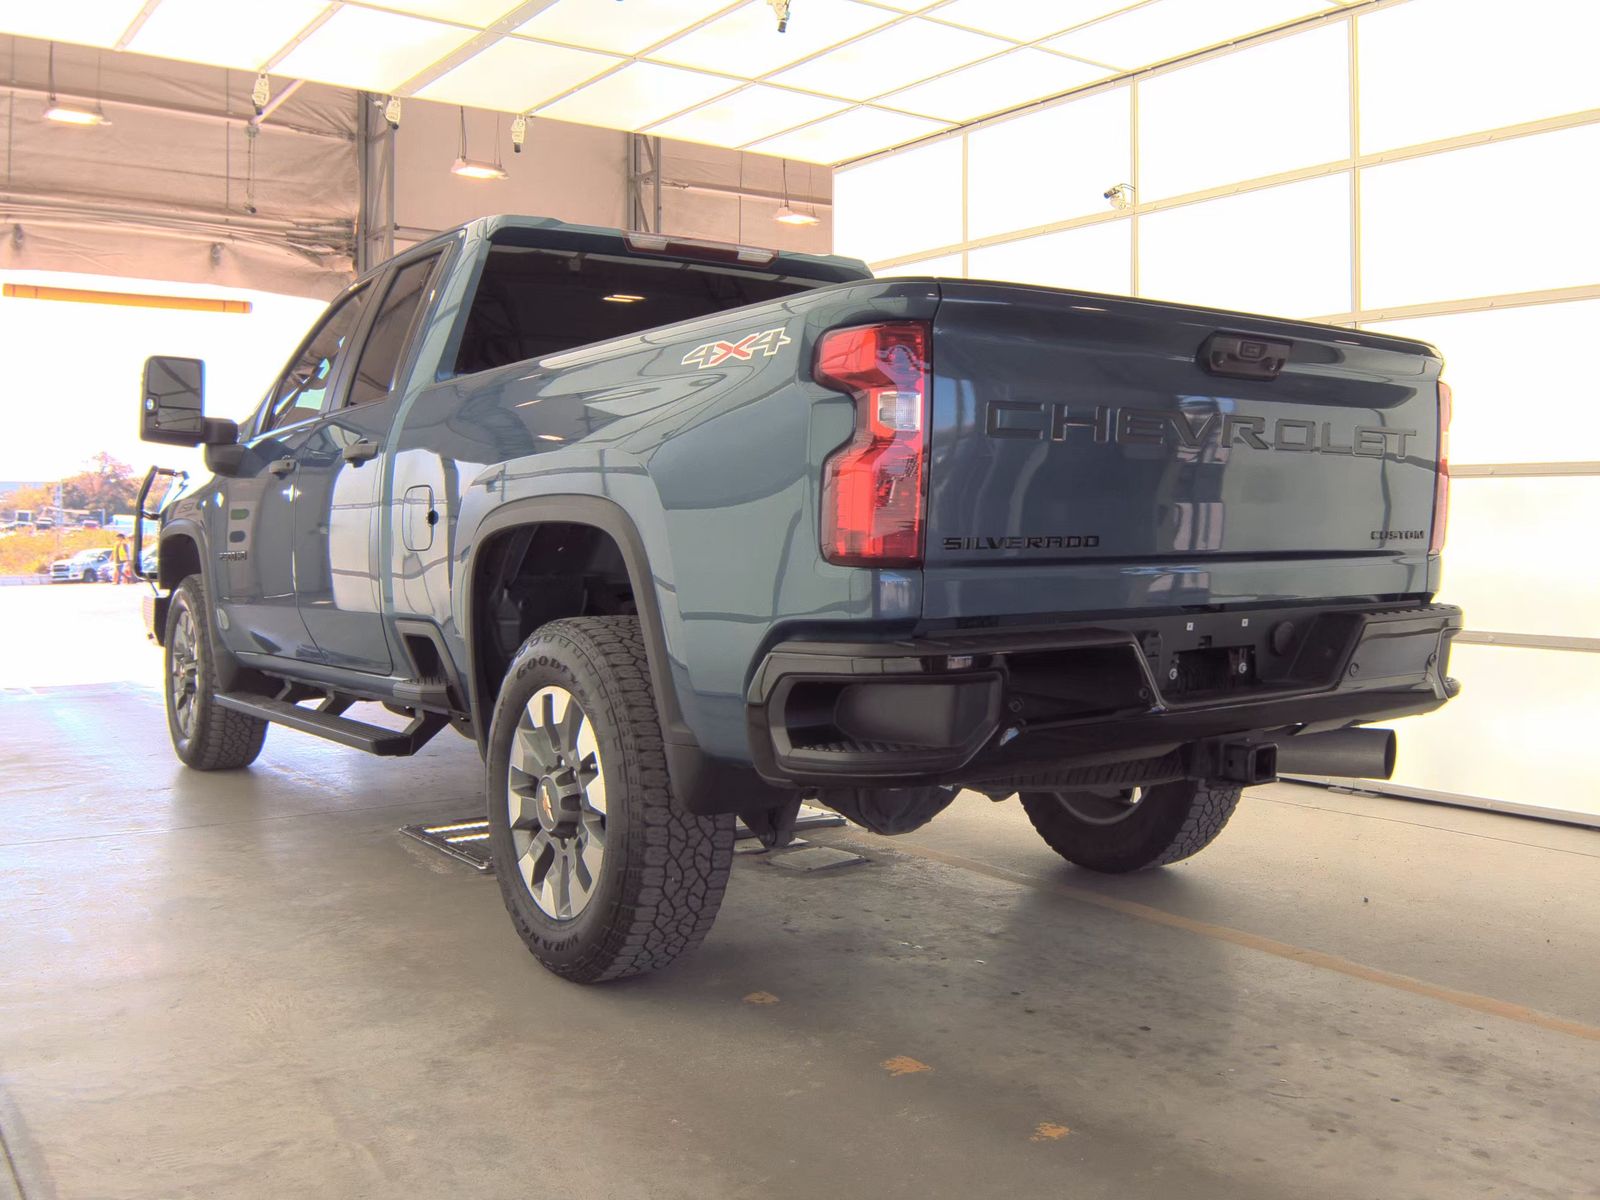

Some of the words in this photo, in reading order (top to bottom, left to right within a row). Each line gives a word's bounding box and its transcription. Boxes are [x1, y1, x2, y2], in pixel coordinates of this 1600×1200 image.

[985, 400, 1417, 458] CHEVROLET
[943, 535, 1100, 550] SILVERADO
[1370, 530, 1424, 540] CUSTOM
